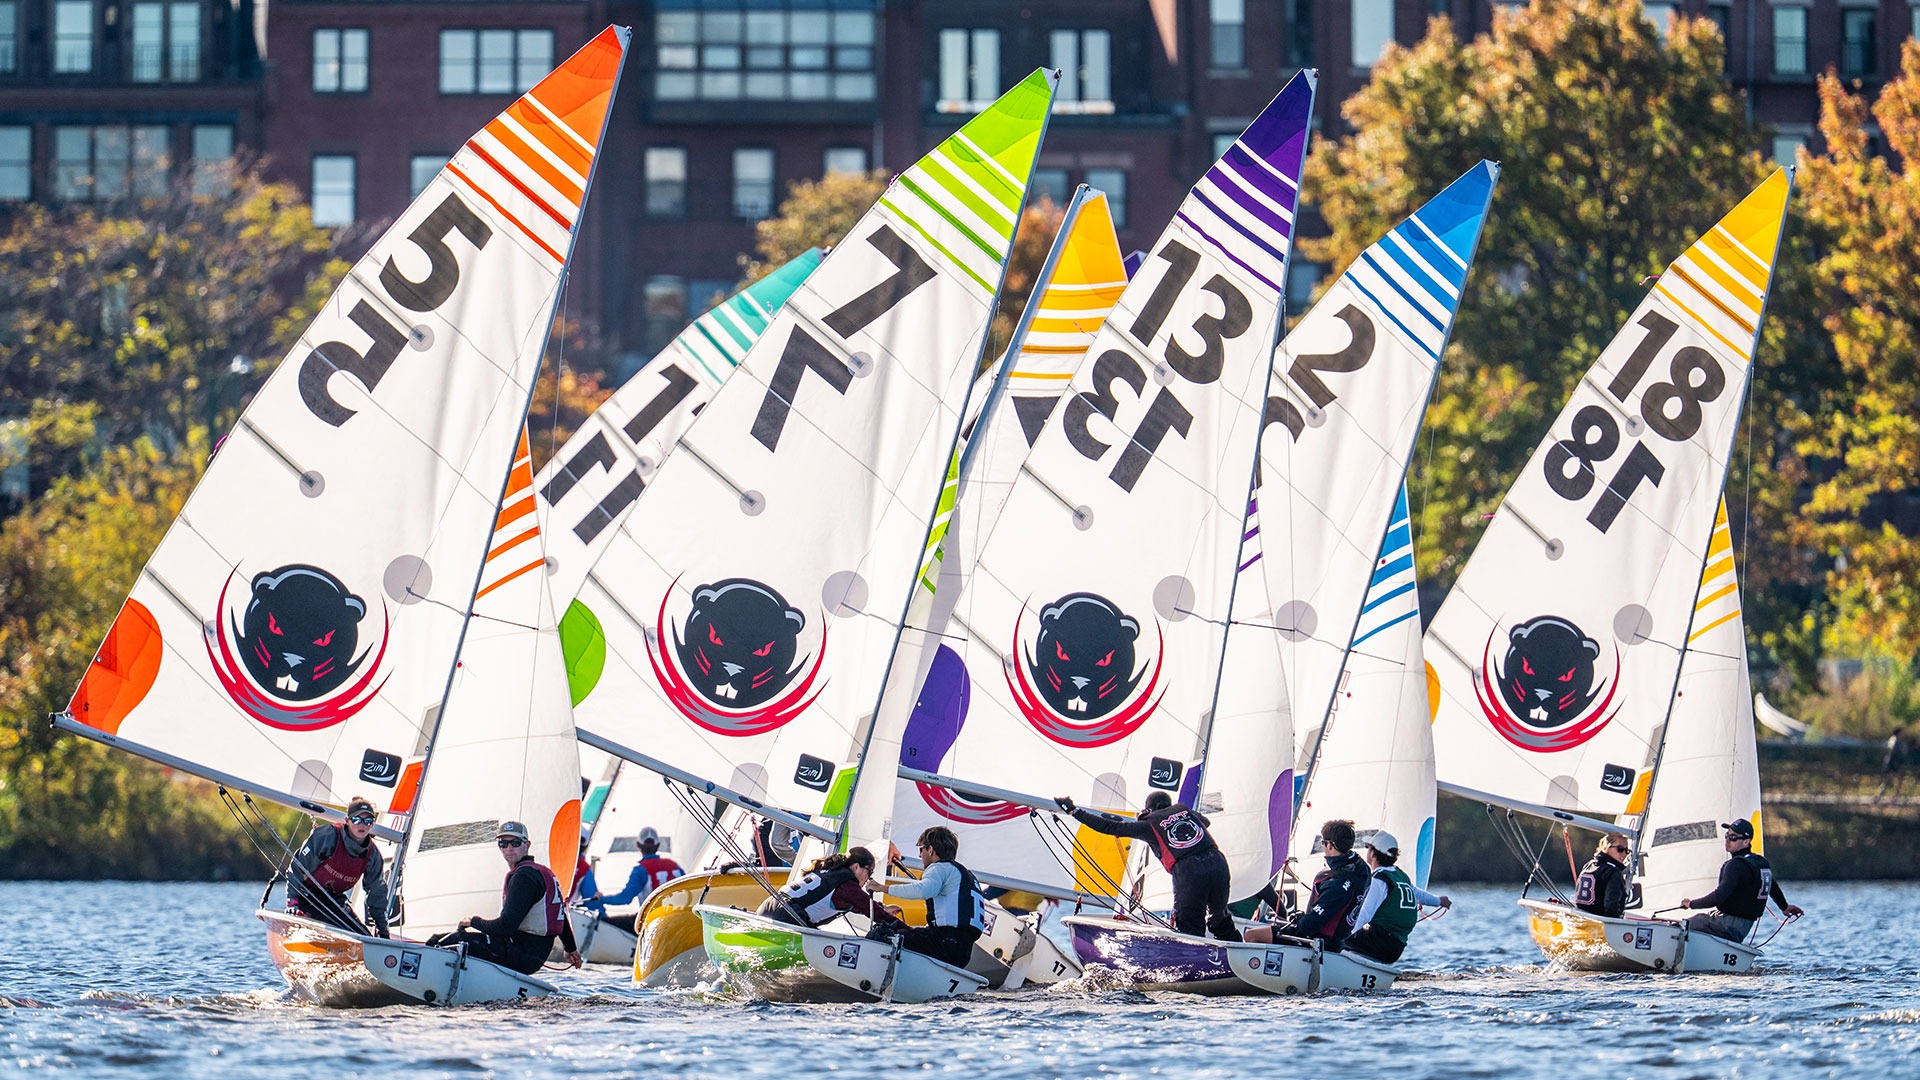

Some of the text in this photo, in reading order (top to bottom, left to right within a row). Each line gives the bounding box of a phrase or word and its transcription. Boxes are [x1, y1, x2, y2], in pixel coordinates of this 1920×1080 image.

[378, 191, 493, 312] 5
[821, 224, 938, 340] 7
[1129, 239, 1253, 384] 13
[1288, 303, 1376, 410] 2
[1607, 309, 1726, 441] 18
[623, 363, 707, 445] 1
[83, 702, 90, 712] 5
[908, 747, 918, 757] 13
[1159, 810, 1188, 831] MIT
[323, 863, 344, 880] BOSTON
[1396, 881, 1417, 909] D
[1574, 873, 1596, 905] B
[1052, 960, 1067, 977] 17
[1723, 953, 1738, 967] 18
[948, 979, 960, 993] 7
[1361, 974, 1377, 989] 13
[517, 986, 528, 1000] 5
